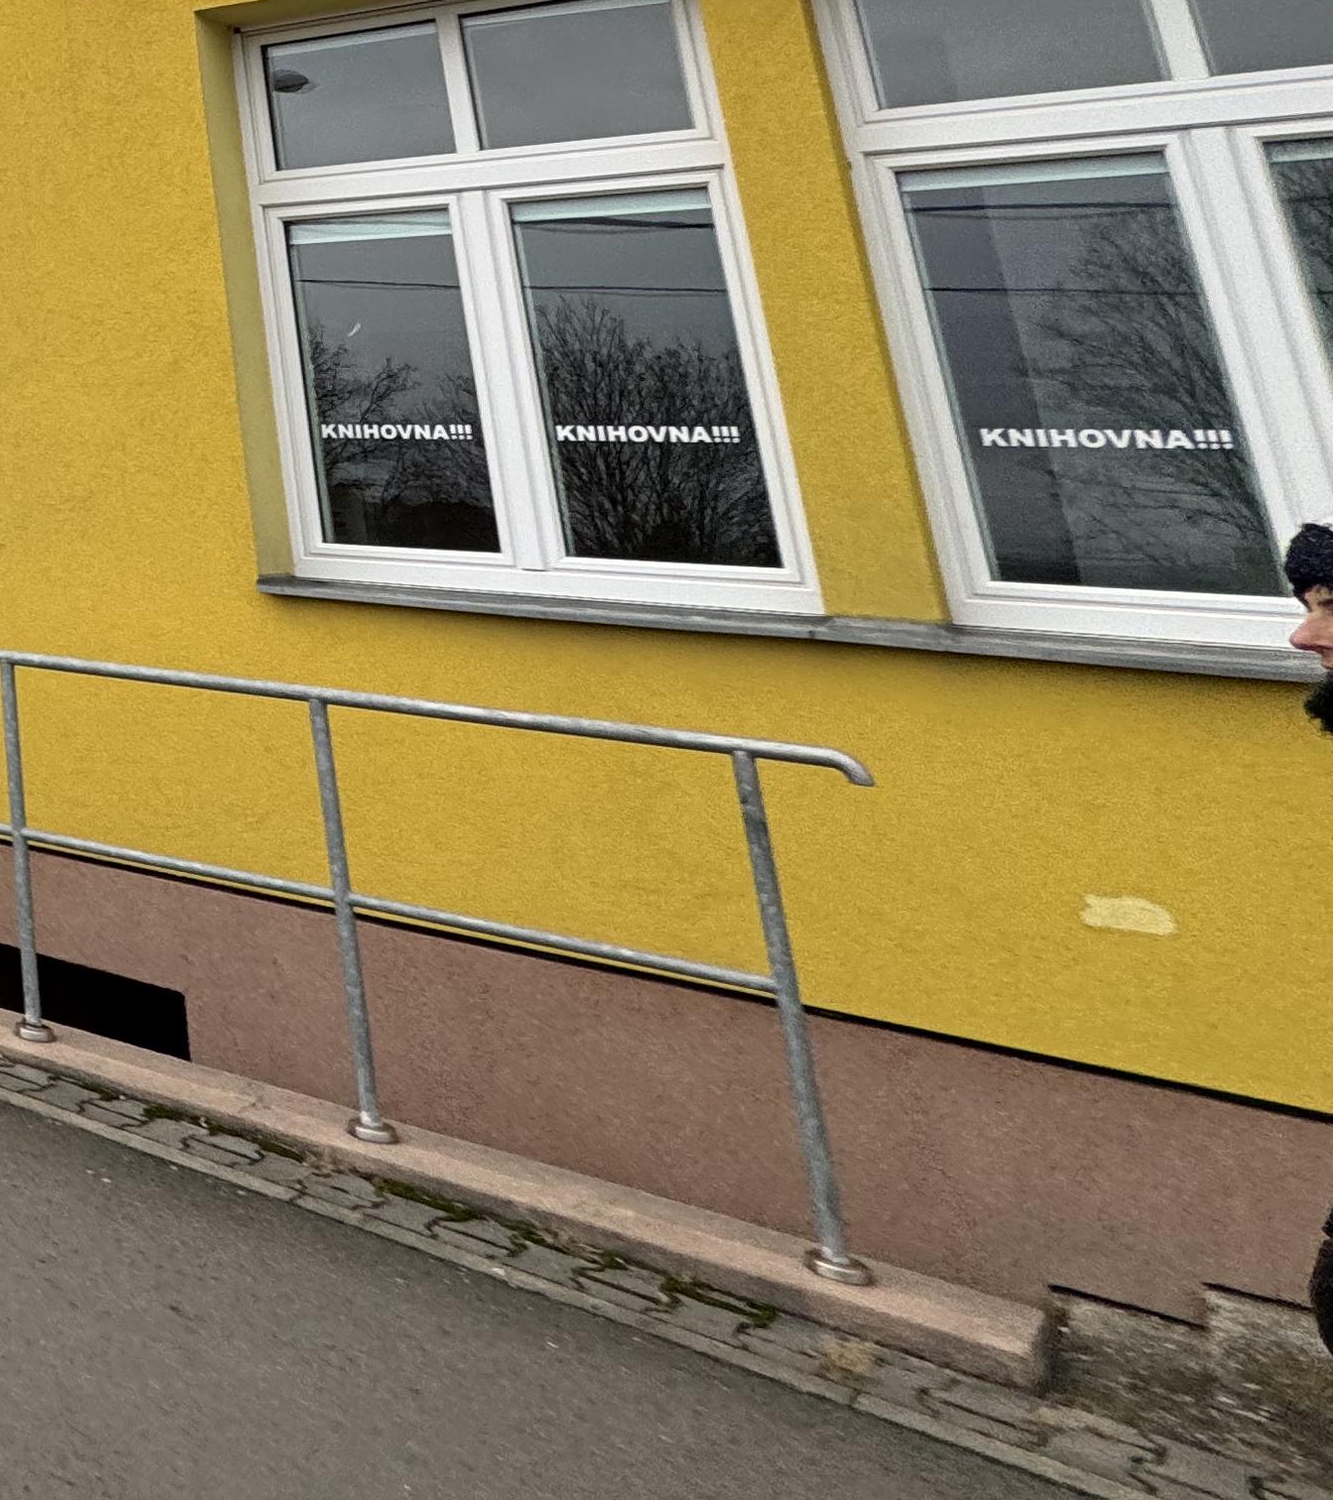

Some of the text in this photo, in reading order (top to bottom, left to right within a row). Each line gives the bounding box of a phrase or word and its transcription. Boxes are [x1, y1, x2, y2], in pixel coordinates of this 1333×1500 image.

[321, 424, 473, 440] KNIHOVNA!!!
[555, 425, 741, 443] KNIHOVNA!!!
[980, 428, 1233, 450] KNIHOVNA!!!
